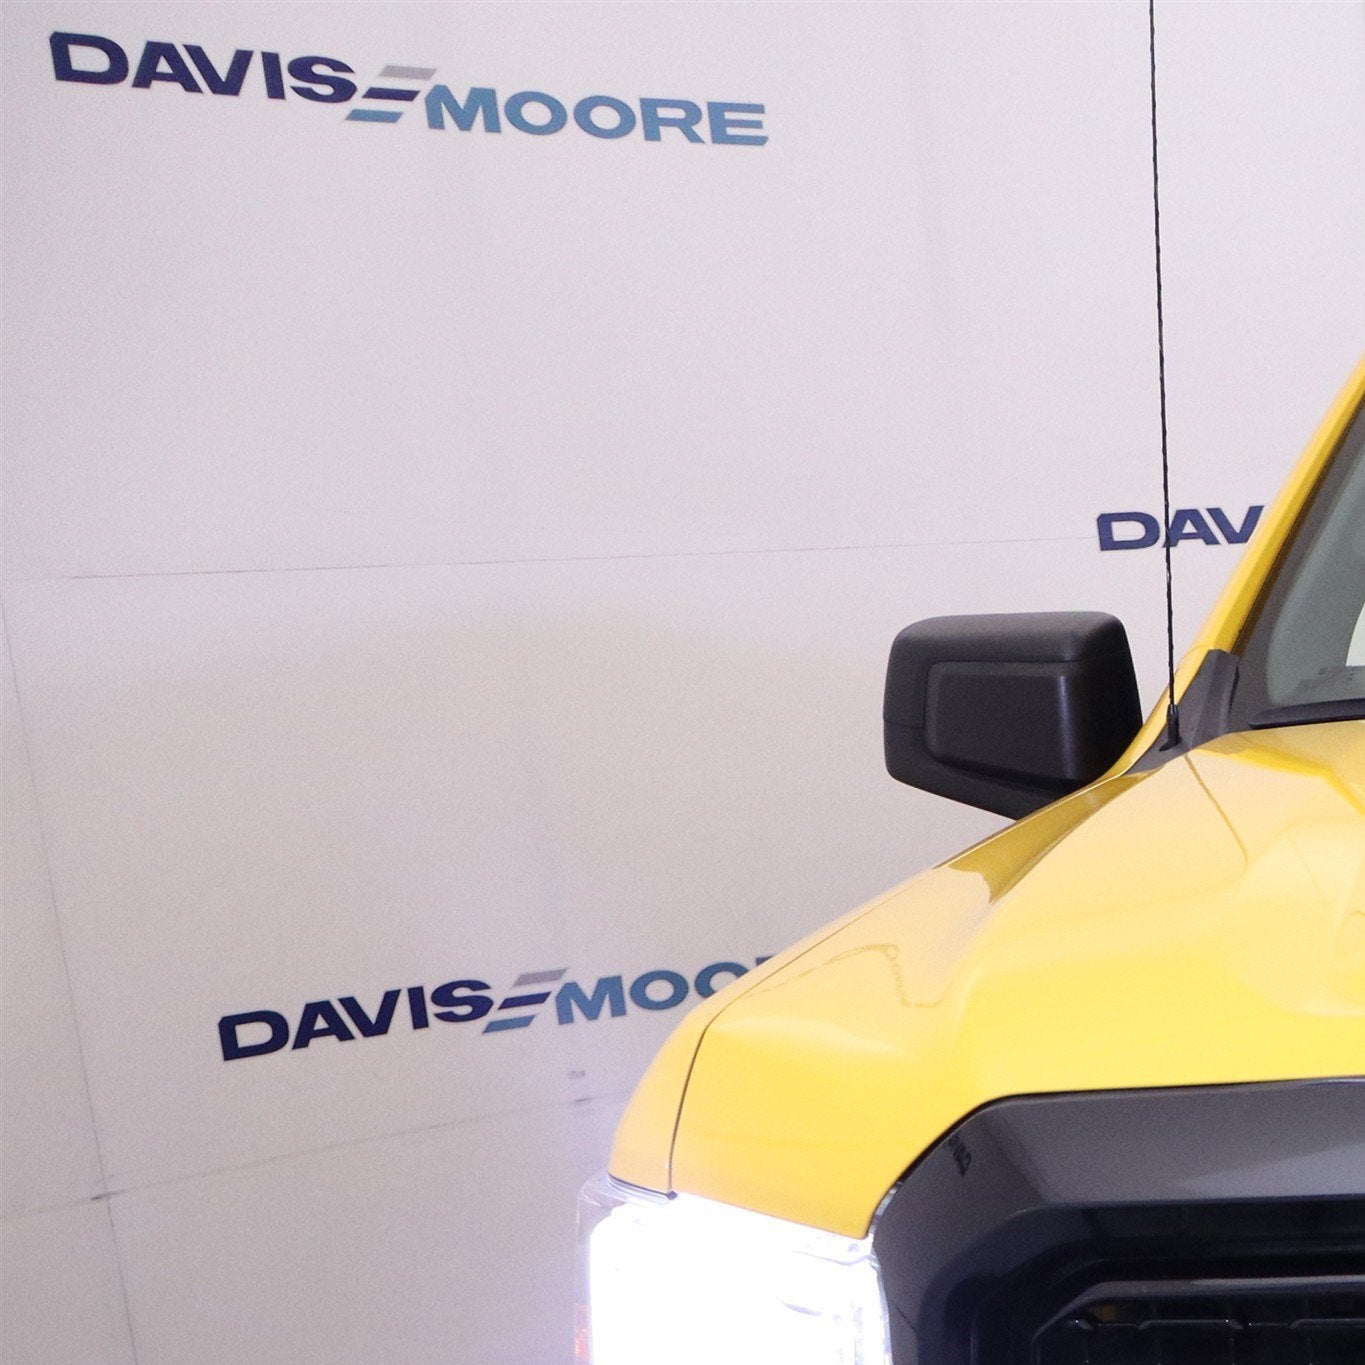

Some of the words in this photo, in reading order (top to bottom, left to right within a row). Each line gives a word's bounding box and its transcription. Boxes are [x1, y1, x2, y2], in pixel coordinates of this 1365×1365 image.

[49, 31, 357, 105] DAVIS
[426, 84, 768, 147] MOORE
[1096, 505, 1264, 551] DAV
[217, 979, 494, 1062] DAVIS
[555, 958, 760, 1026] MOO
